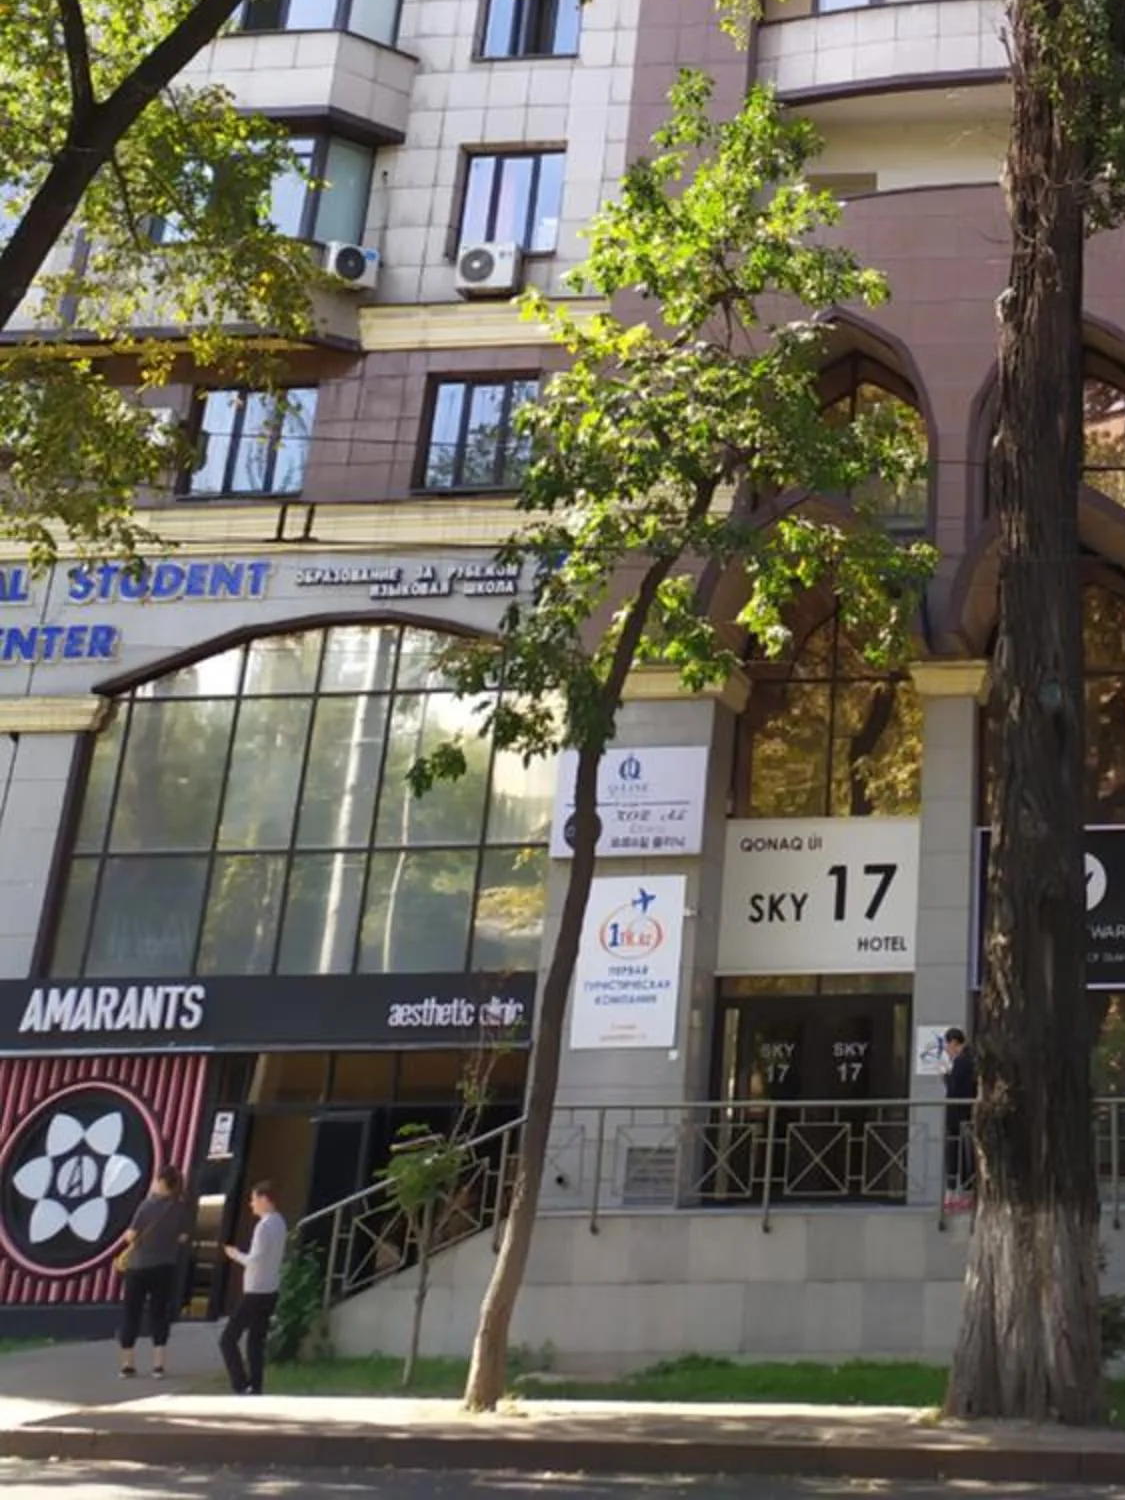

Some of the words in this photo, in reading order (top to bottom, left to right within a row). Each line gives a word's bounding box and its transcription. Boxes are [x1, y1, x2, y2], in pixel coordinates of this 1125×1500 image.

[68, 562, 272, 600] STUDENT
[296, 568, 402, 585] ОБРАЗОВАНИЕ
[416, 566, 435, 581] ЗА
[448, 563, 520, 581] РУБЕЖОМ
[369, 581, 453, 599] ЯЗЫКОВАЯ
[463, 579, 517, 596] ШКОЛА
[0, 623, 119, 660] NTER
[740, 837, 803, 851] QONAQ
[748, 893, 808, 923] SKY
[828, 864, 897, 921] 17
[857, 936, 907, 951] HOTEL
[18, 985, 206, 1033] AMARANTS
[388, 996, 475, 1027] aesthetic
[833, 1041, 868, 1057] SKY
[767, 1063, 790, 1083] 17
[838, 1062, 863, 1082] 17
